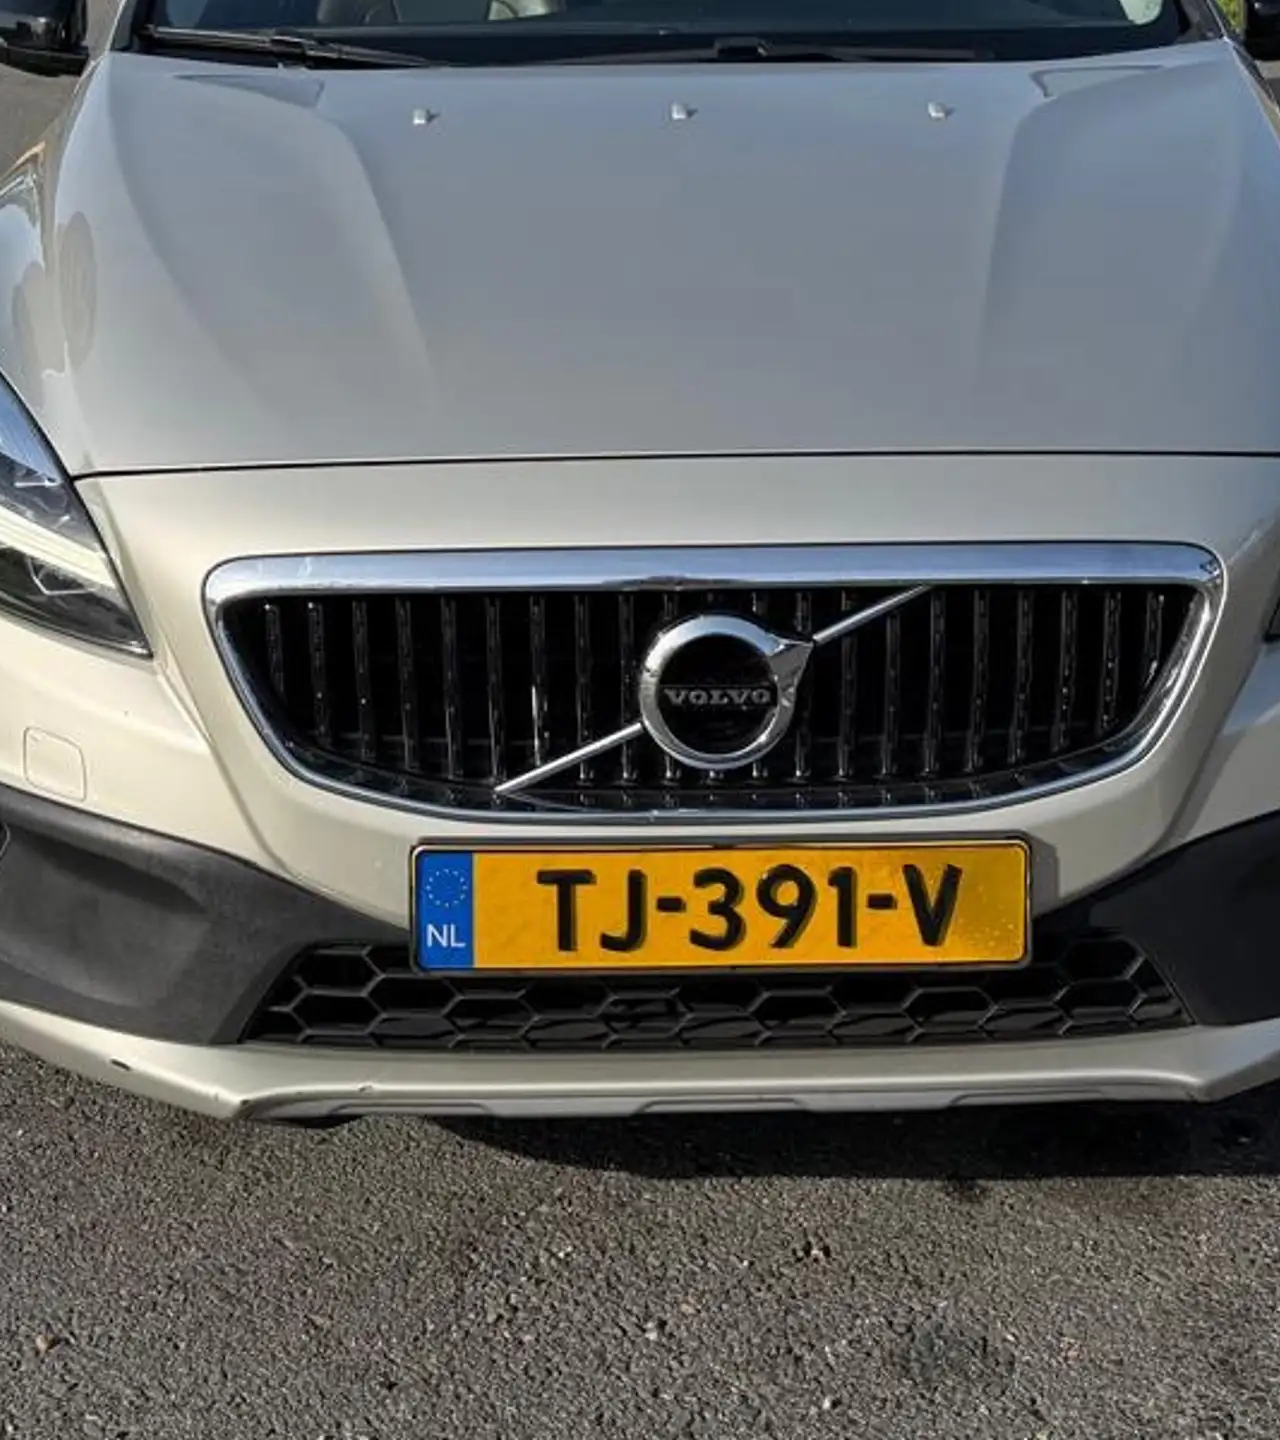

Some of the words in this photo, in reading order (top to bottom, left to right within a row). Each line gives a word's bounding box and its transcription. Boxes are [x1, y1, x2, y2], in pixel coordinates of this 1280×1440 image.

[663, 688, 771, 706] VOLVO
[425, 923, 467, 948] NL
[535, 863, 964, 952] TJ-391-V
